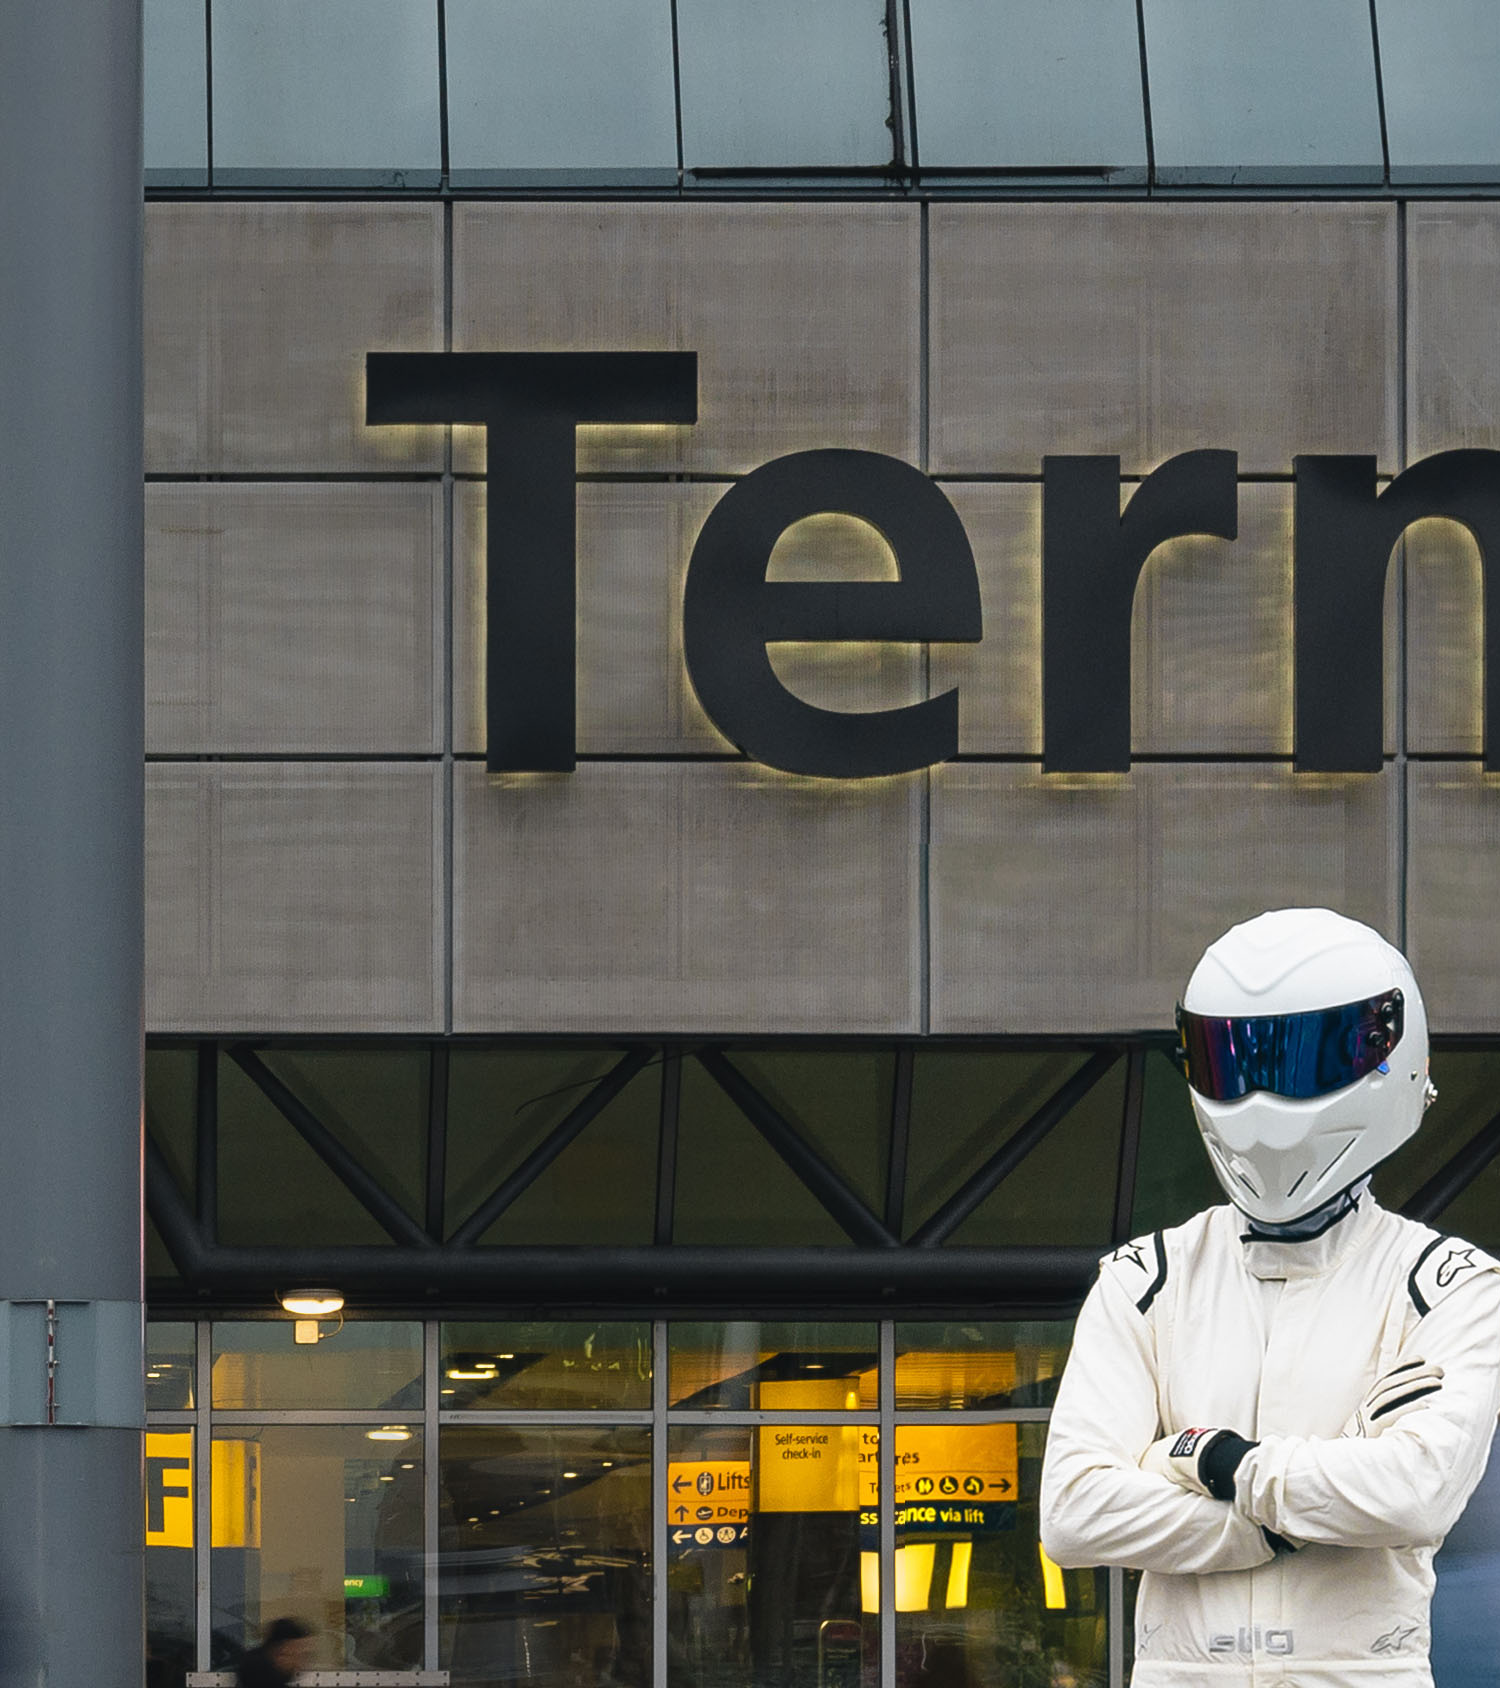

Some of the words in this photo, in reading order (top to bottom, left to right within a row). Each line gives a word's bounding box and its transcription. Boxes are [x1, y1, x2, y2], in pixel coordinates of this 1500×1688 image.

[775, 1433, 828, 1445] Self-service
[782, 1448, 821, 1460] check-in
[718, 1472, 750, 1491] Lifts
[146, 1457, 190, 1533] F
[940, 1507, 962, 1524] via
[964, 1508, 985, 1524] lift
